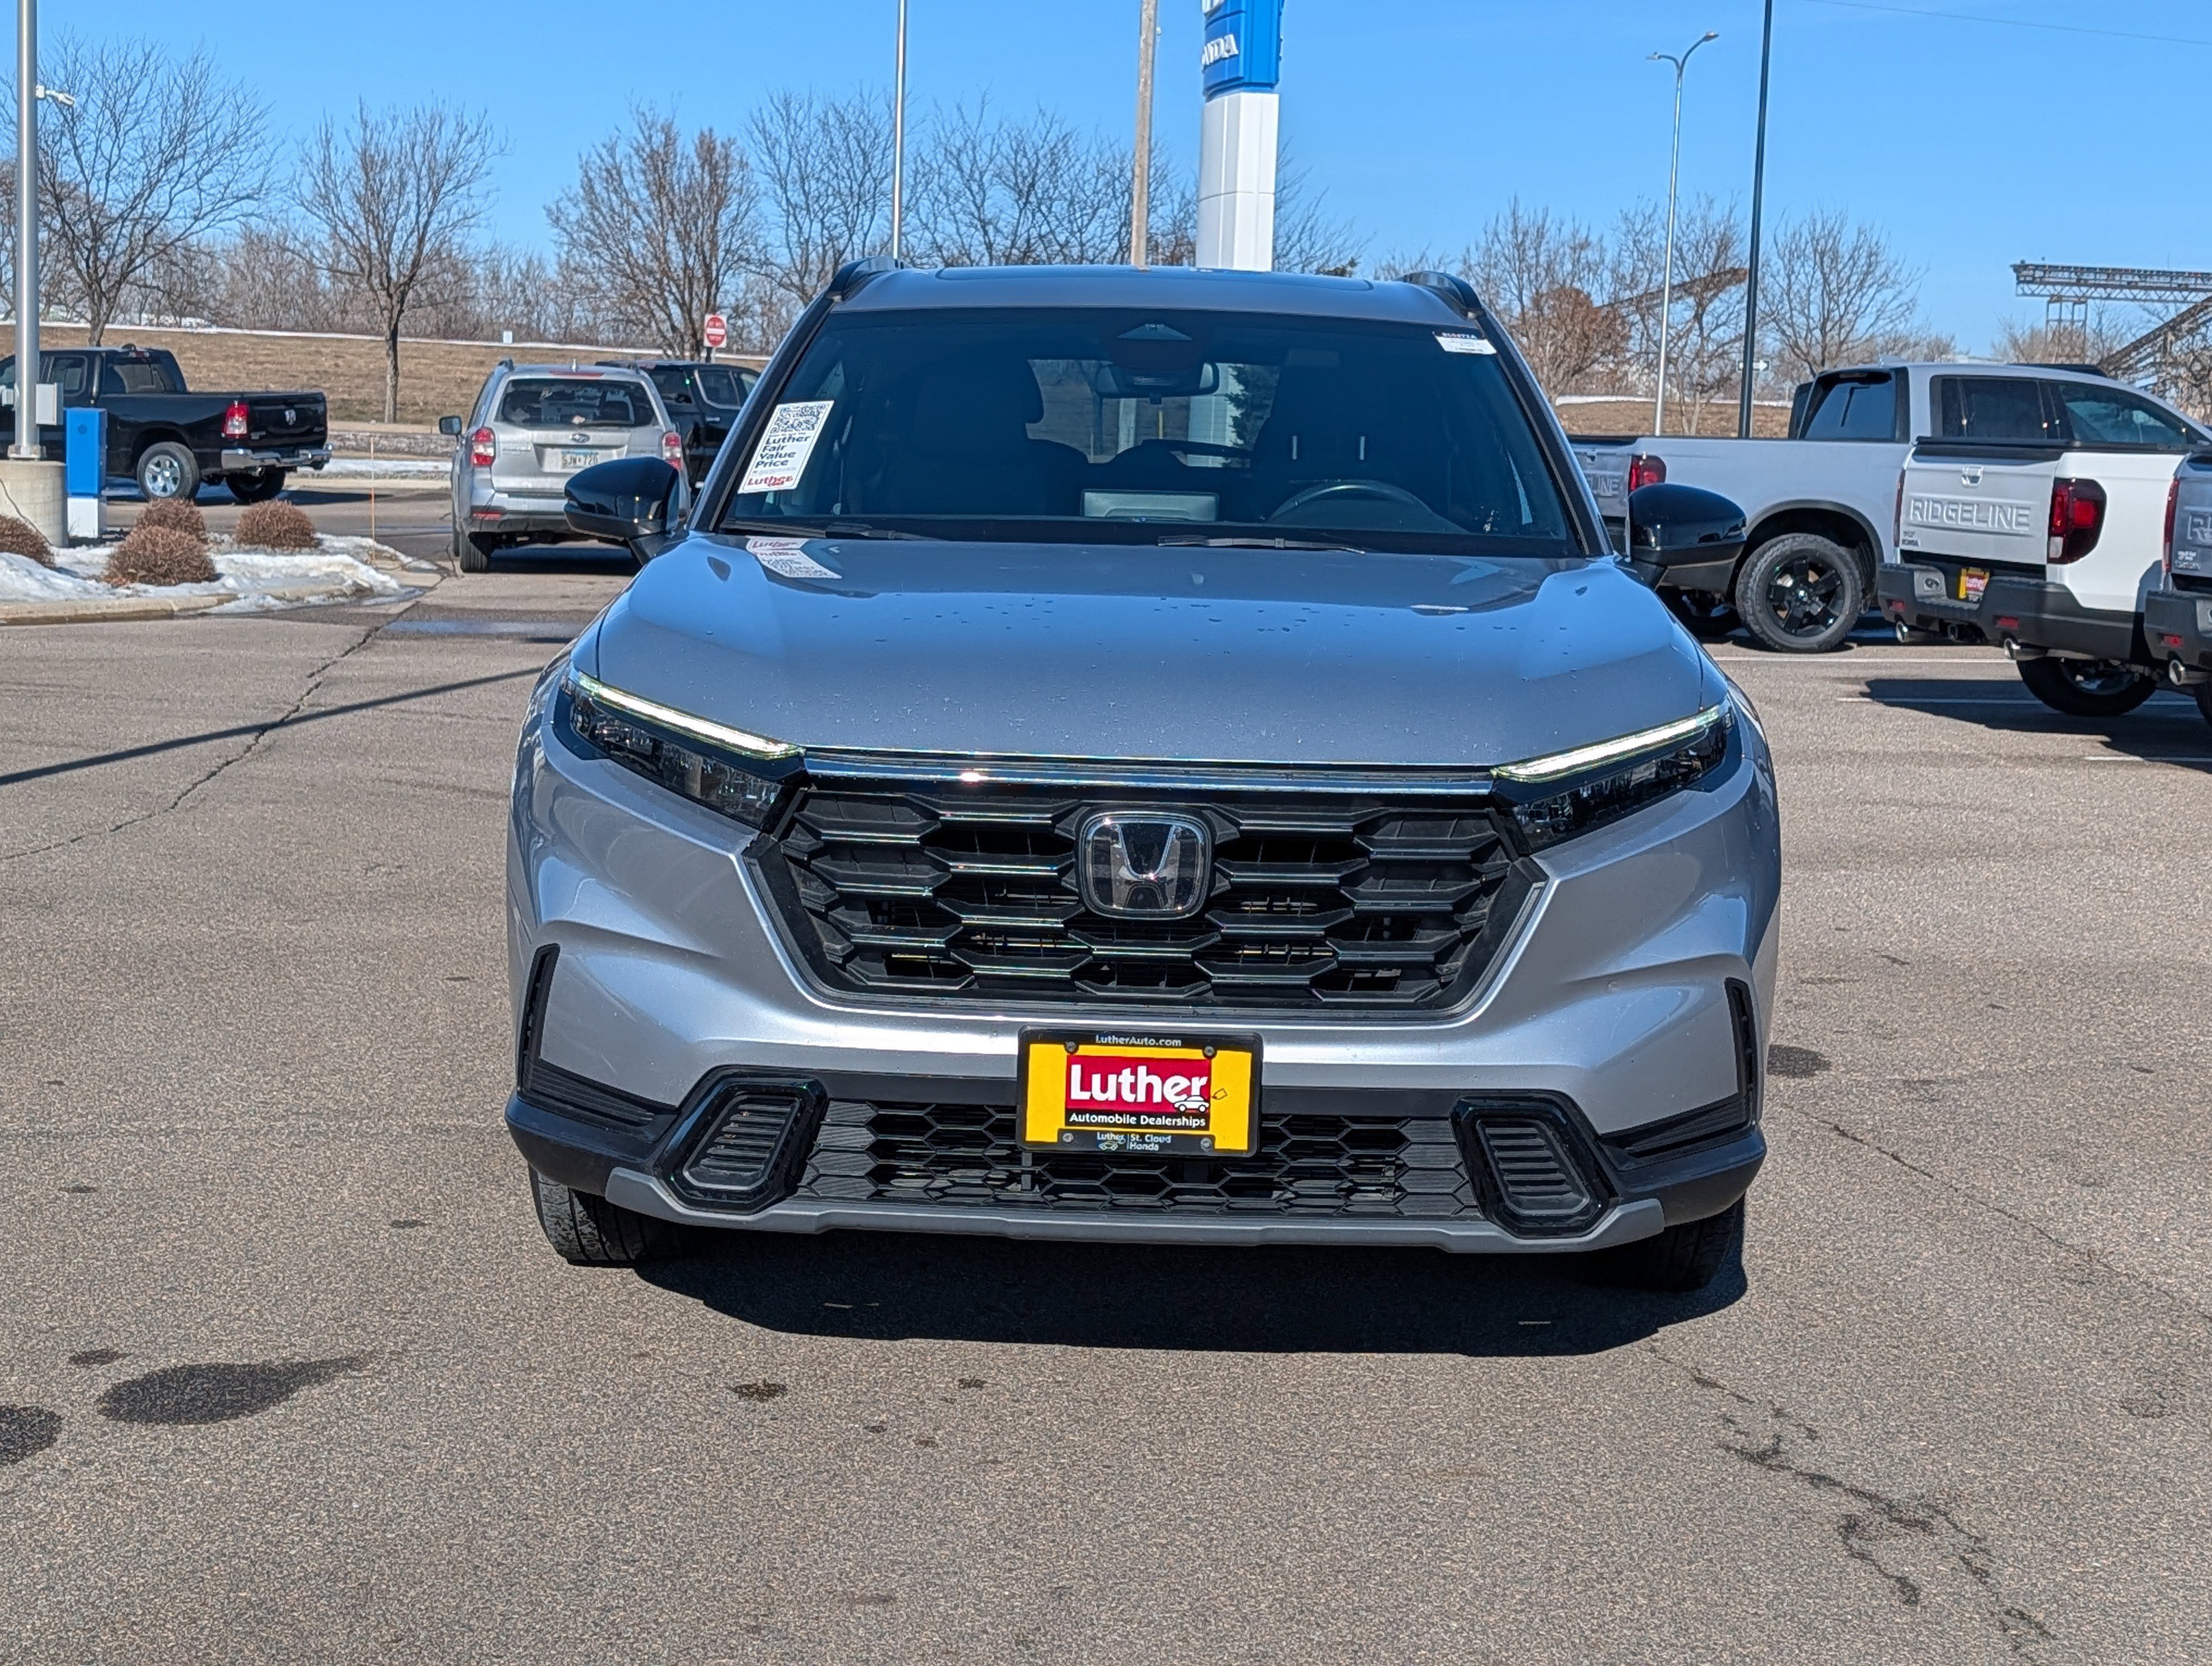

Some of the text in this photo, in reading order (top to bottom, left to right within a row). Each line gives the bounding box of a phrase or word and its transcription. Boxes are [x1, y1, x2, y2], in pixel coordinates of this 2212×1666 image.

[766, 435, 811, 445] Luther
[760, 452, 796, 460] Value
[755, 460, 789, 469] Price
[1909, 498, 2031, 531] RIDGELINE
[1095, 1034, 1182, 1047] LutherAuto.com
[1070, 1063, 1208, 1104] Luther
[1069, 1113, 1206, 1128] Automobile Dealerships
[1130, 1133, 1142, 1142] St.
[1144, 1134, 1172, 1143] Cloud
[1130, 1141, 1159, 1151] Honda
